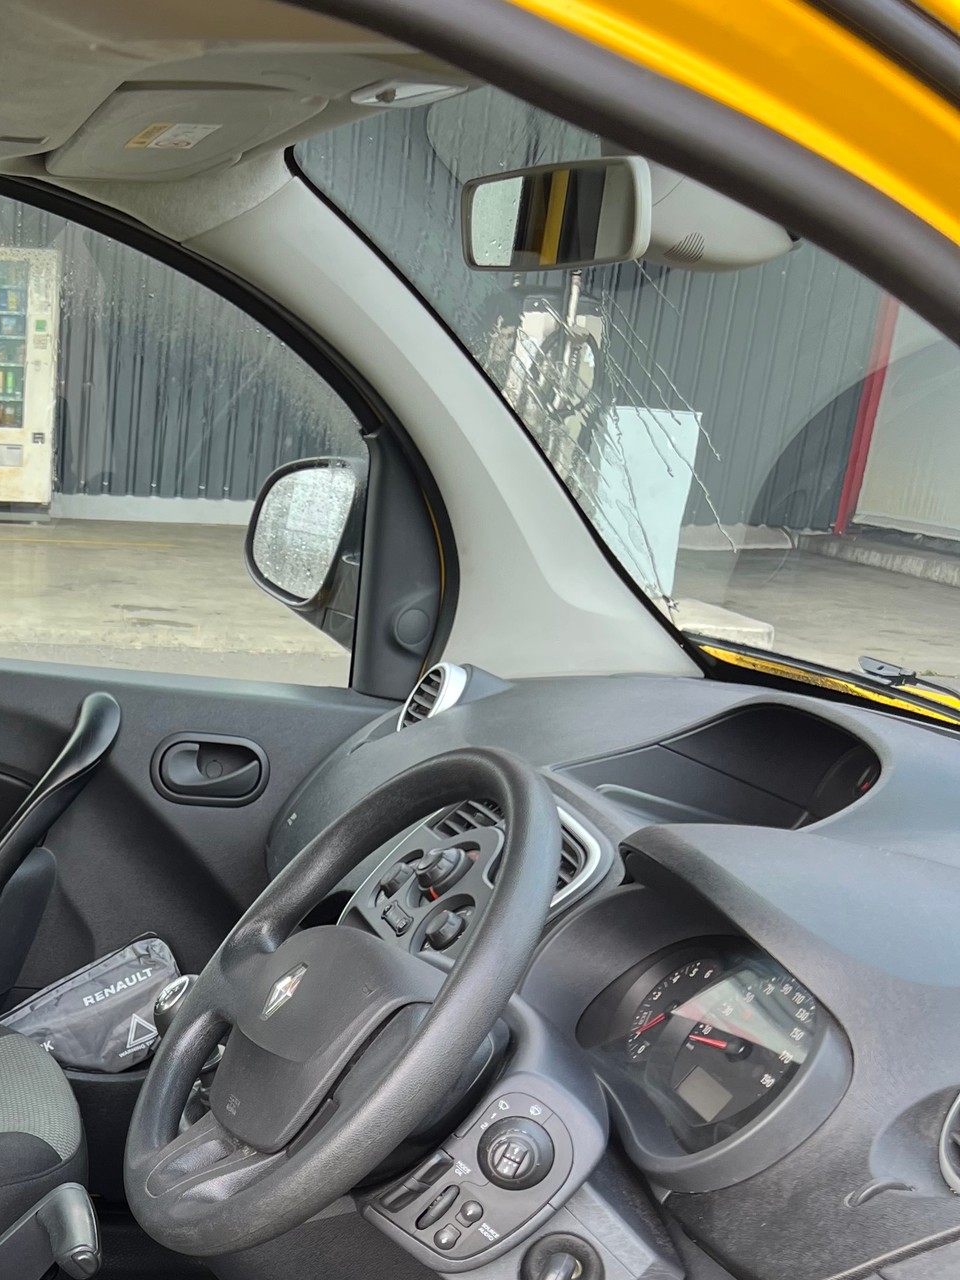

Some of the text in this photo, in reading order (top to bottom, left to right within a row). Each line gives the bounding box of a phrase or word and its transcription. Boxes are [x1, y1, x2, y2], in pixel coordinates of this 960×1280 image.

[689, 967, 699, 977] 5
[704, 969, 714, 979] 6
[82, 967, 153, 1007] RENAULT
[763, 983, 776, 996] 70
[780, 983, 793, 995] 90
[652, 991, 662, 1001] 3
[744, 991, 755, 1003] 50
[792, 992, 806, 1005] 110
[795, 1008, 810, 1021] 130
[702, 1024, 713, 1035] 10
[789, 1027, 805, 1041] 150
[118, 1042, 146, 1058] WARNING
[637, 1045, 646, 1055] 0
[778, 1050, 793, 1064] 170
[760, 1073, 776, 1088] 190
[480, 1122, 489, 1130] 2
[478, 1227, 494, 1241] AUDIO
[481, 1222, 500, 1239] SOURCE
